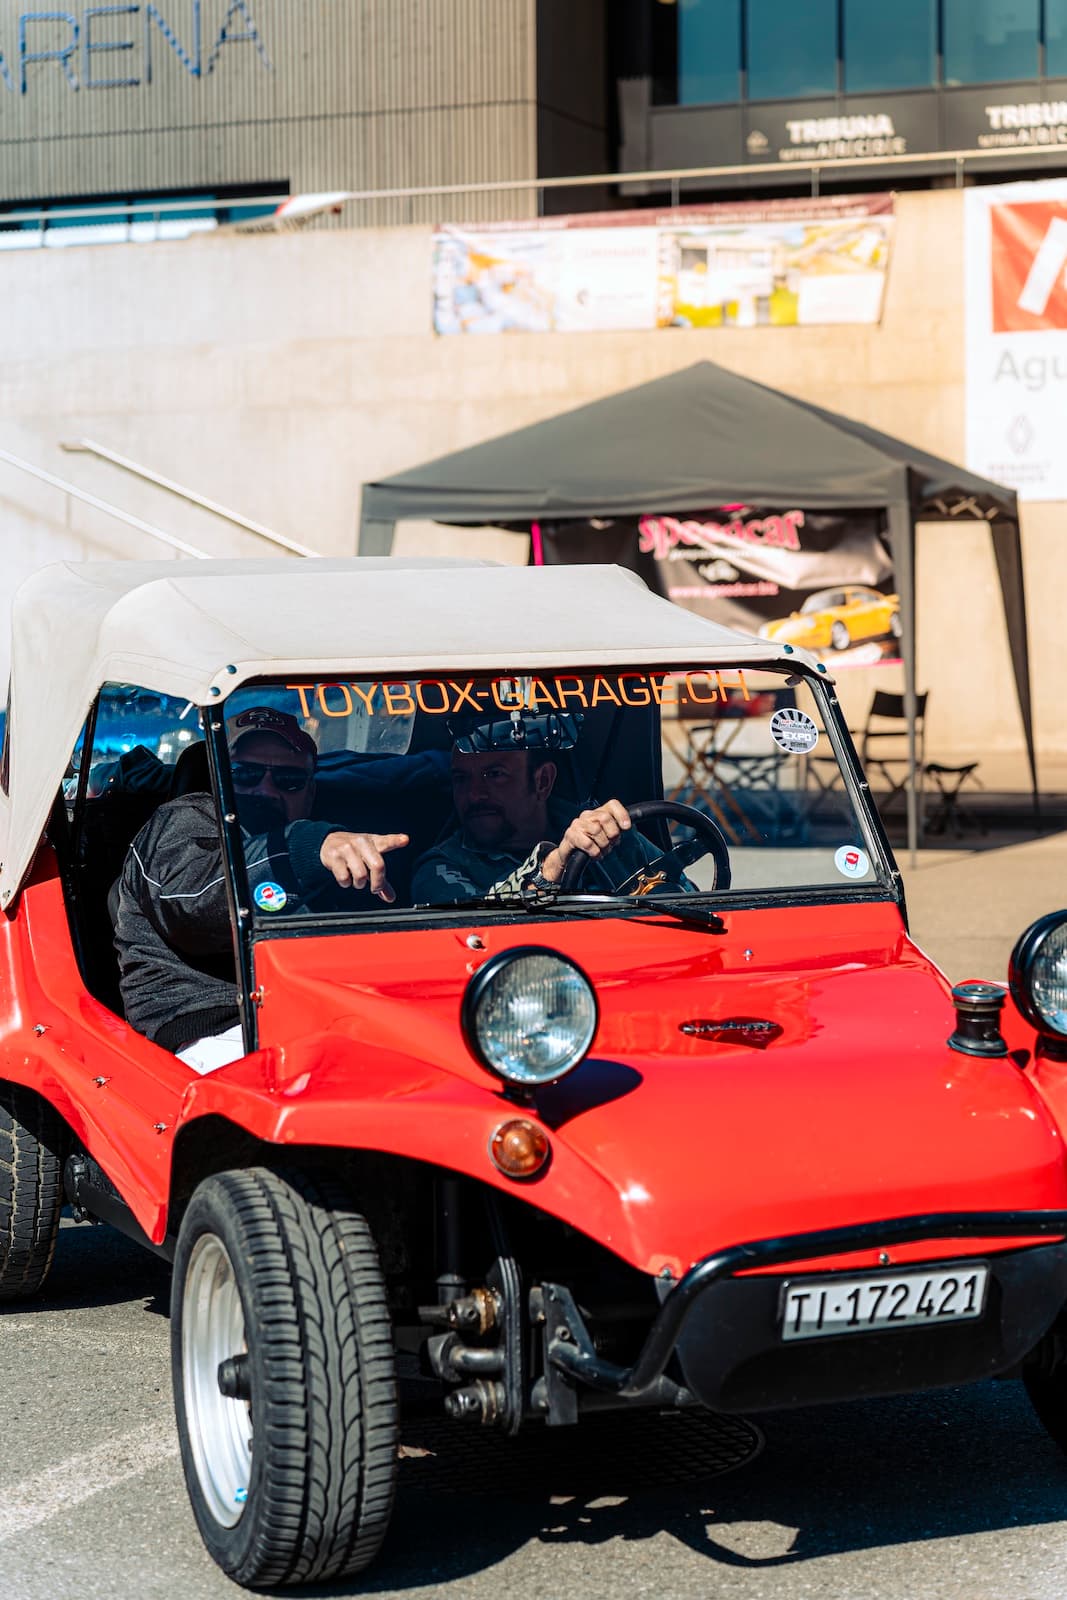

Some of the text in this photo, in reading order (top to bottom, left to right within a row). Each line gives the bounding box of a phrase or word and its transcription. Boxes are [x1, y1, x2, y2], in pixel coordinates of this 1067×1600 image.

[0, 0, 273, 95] RENA
[786, 113, 895, 144] TRIBUNA
[286, 669, 751, 718] TOYBOX-GARAGE.CH
